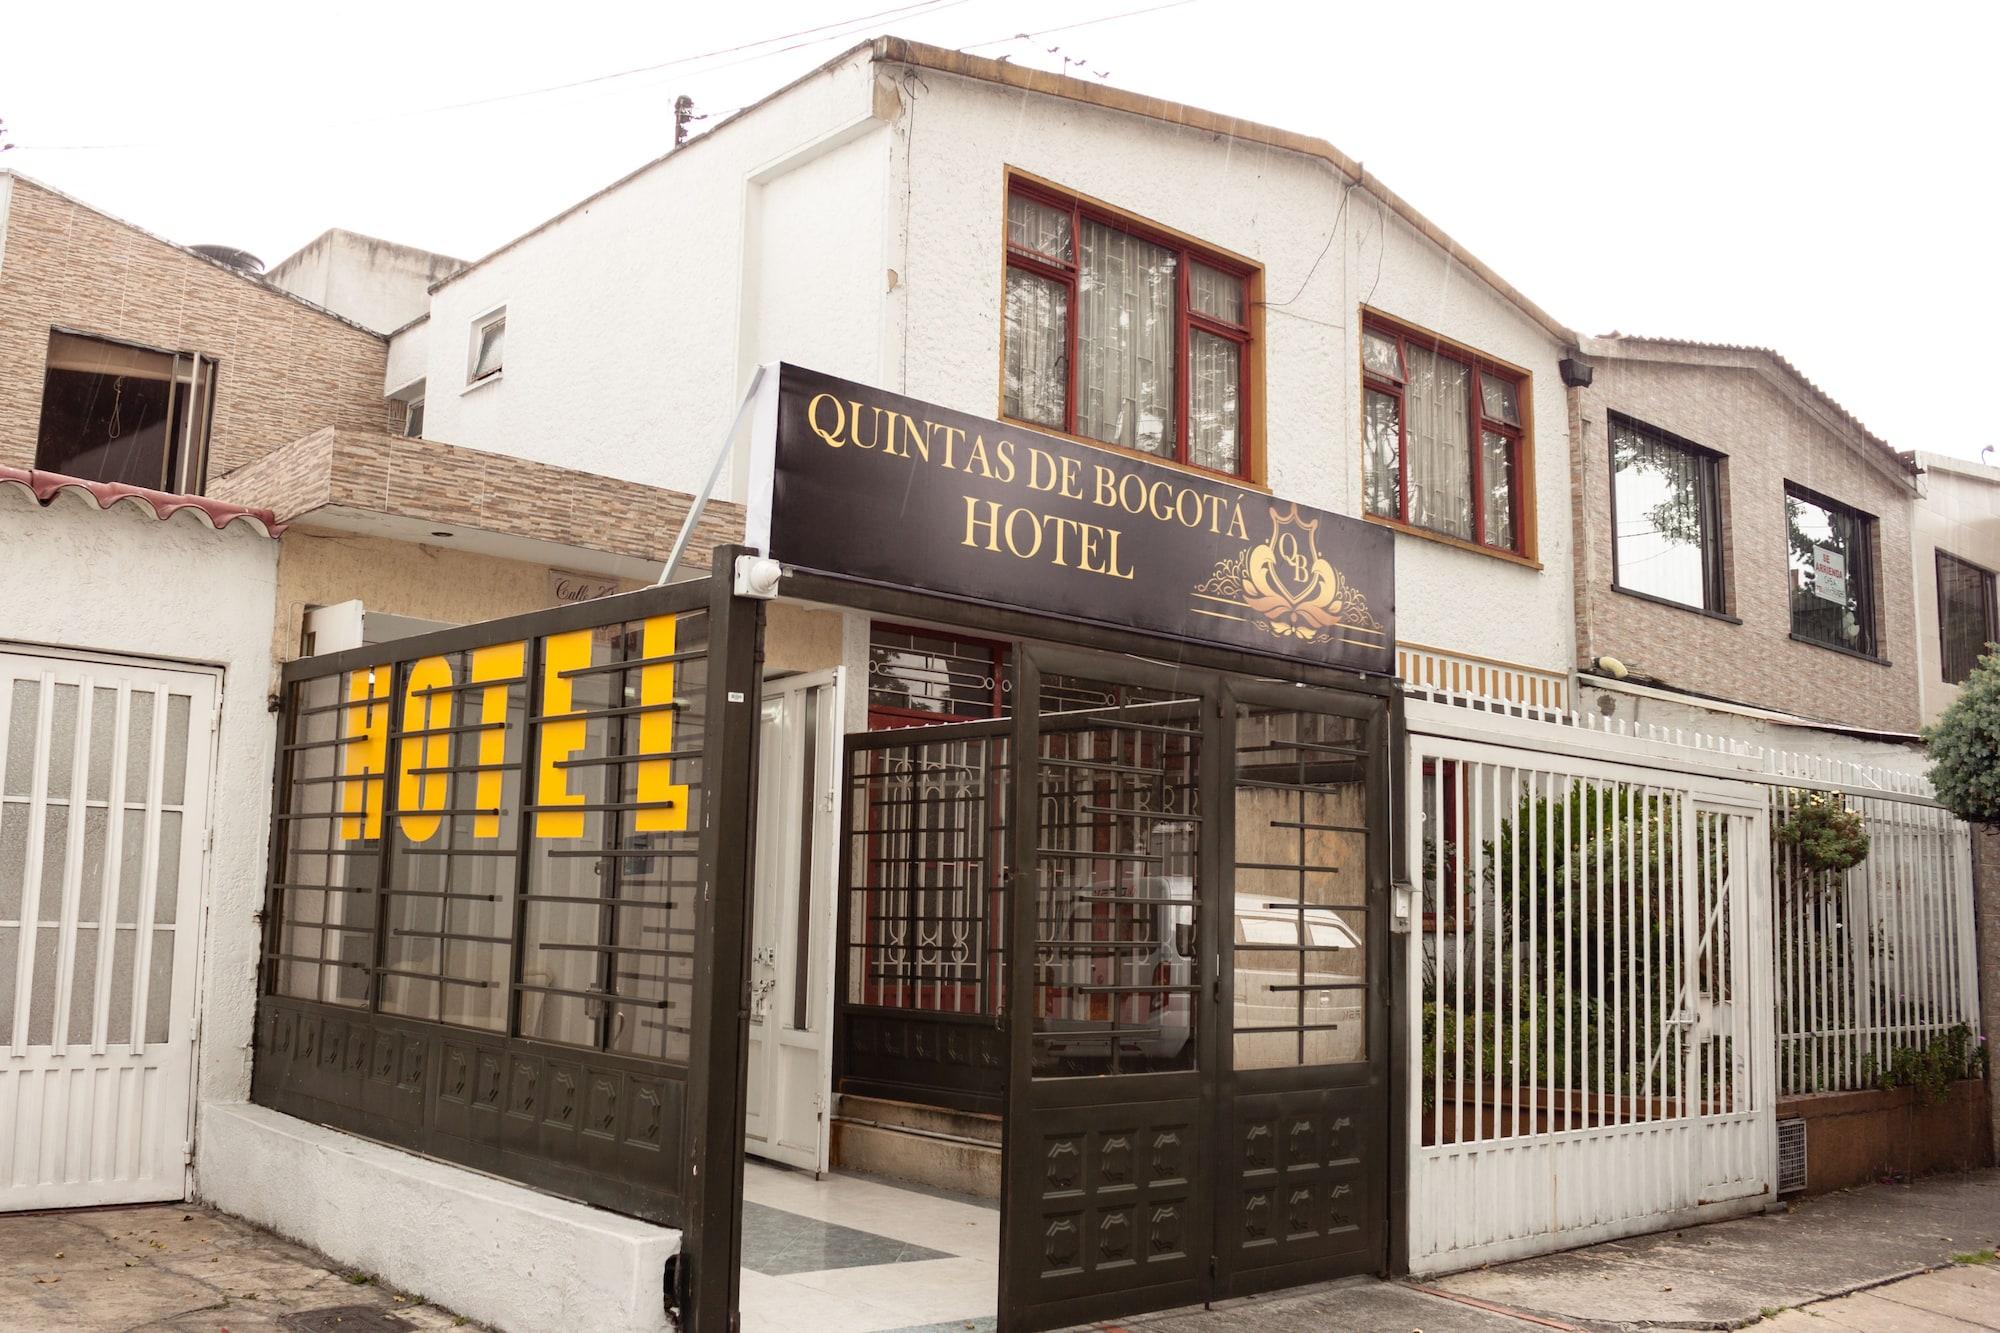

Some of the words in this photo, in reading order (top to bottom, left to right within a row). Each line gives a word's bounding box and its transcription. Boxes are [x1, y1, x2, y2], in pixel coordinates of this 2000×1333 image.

[807, 392, 1015, 483] QUINTAS
[1026, 447, 1084, 500] DE
[1092, 464, 1250, 541] BOGOTÁ
[961, 495, 1135, 581] HOTEL
[1815, 561, 1843, 579] ARRIENDA
[341, 614, 689, 842] HOTEL
